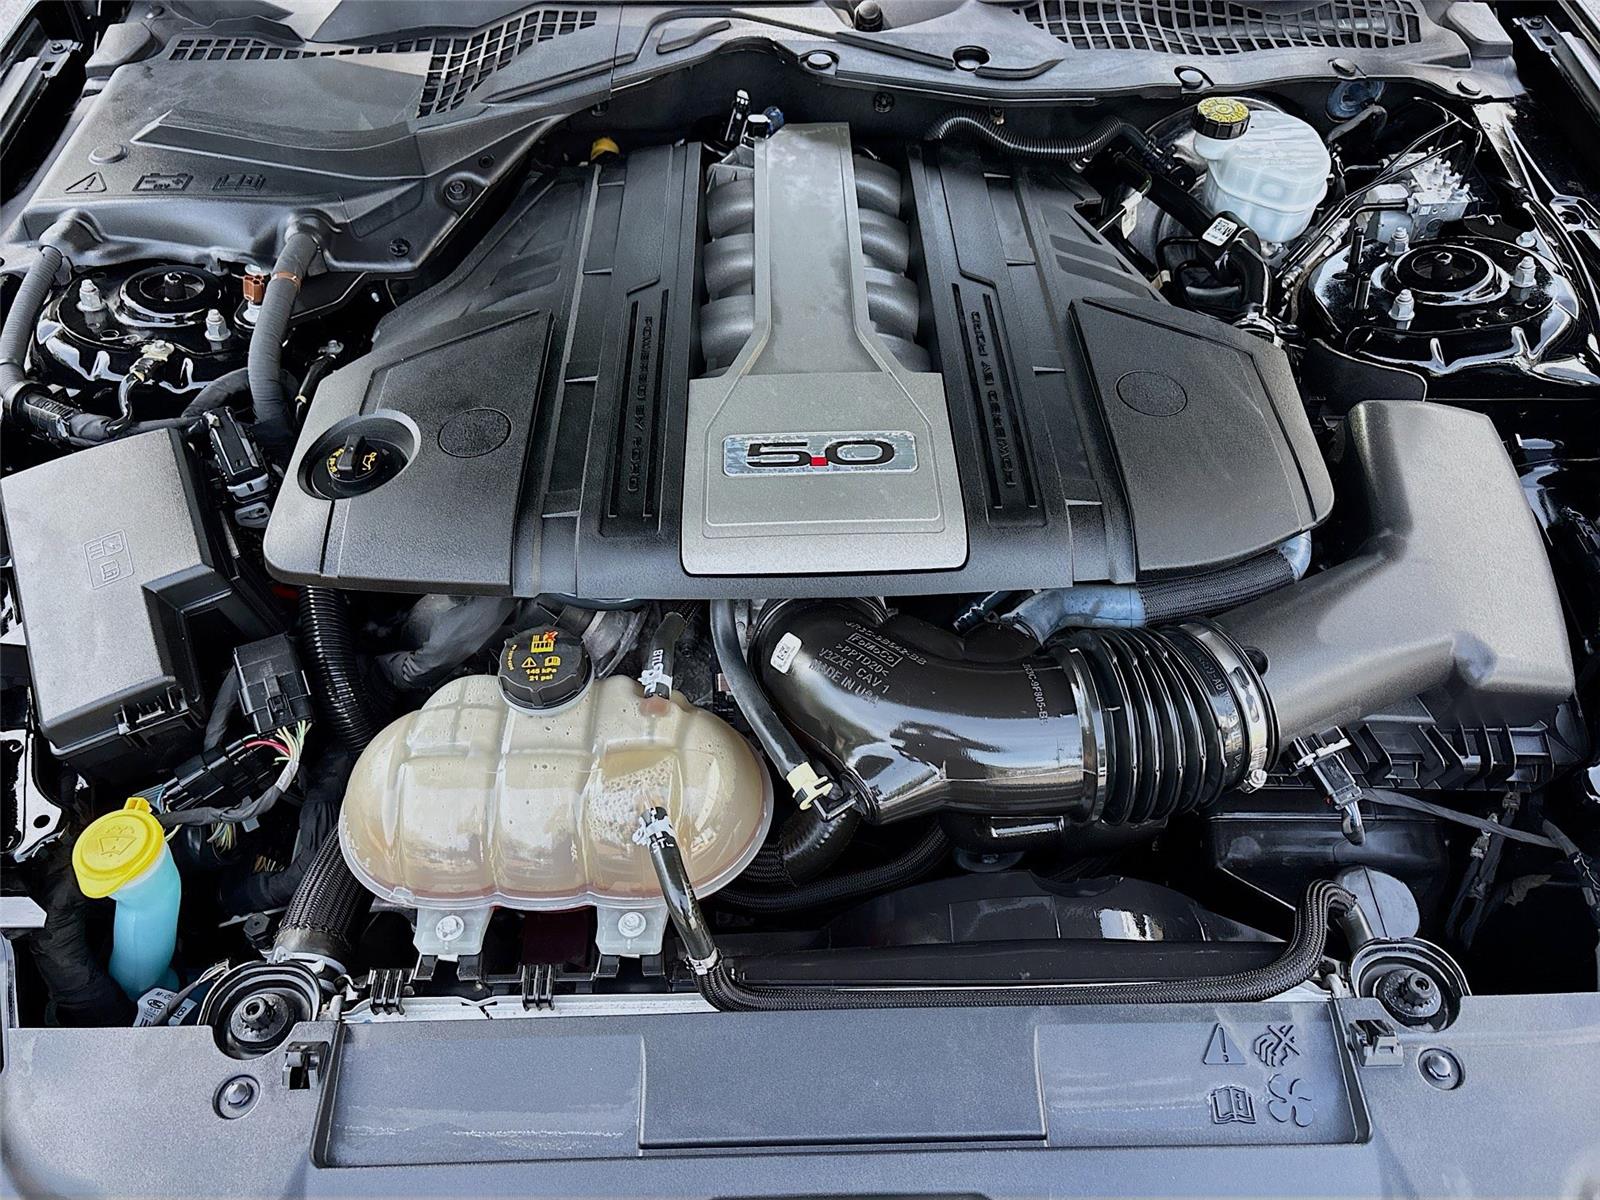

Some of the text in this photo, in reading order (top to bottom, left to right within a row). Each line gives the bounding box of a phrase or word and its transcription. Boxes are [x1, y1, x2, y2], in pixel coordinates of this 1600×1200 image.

[745, 438, 895, 468] 5.0
[851, 635, 895, 662] FoMoCo
[841, 676, 856, 690] IN
[855, 667, 882, 687] CAV
[882, 684, 890, 694] 1
